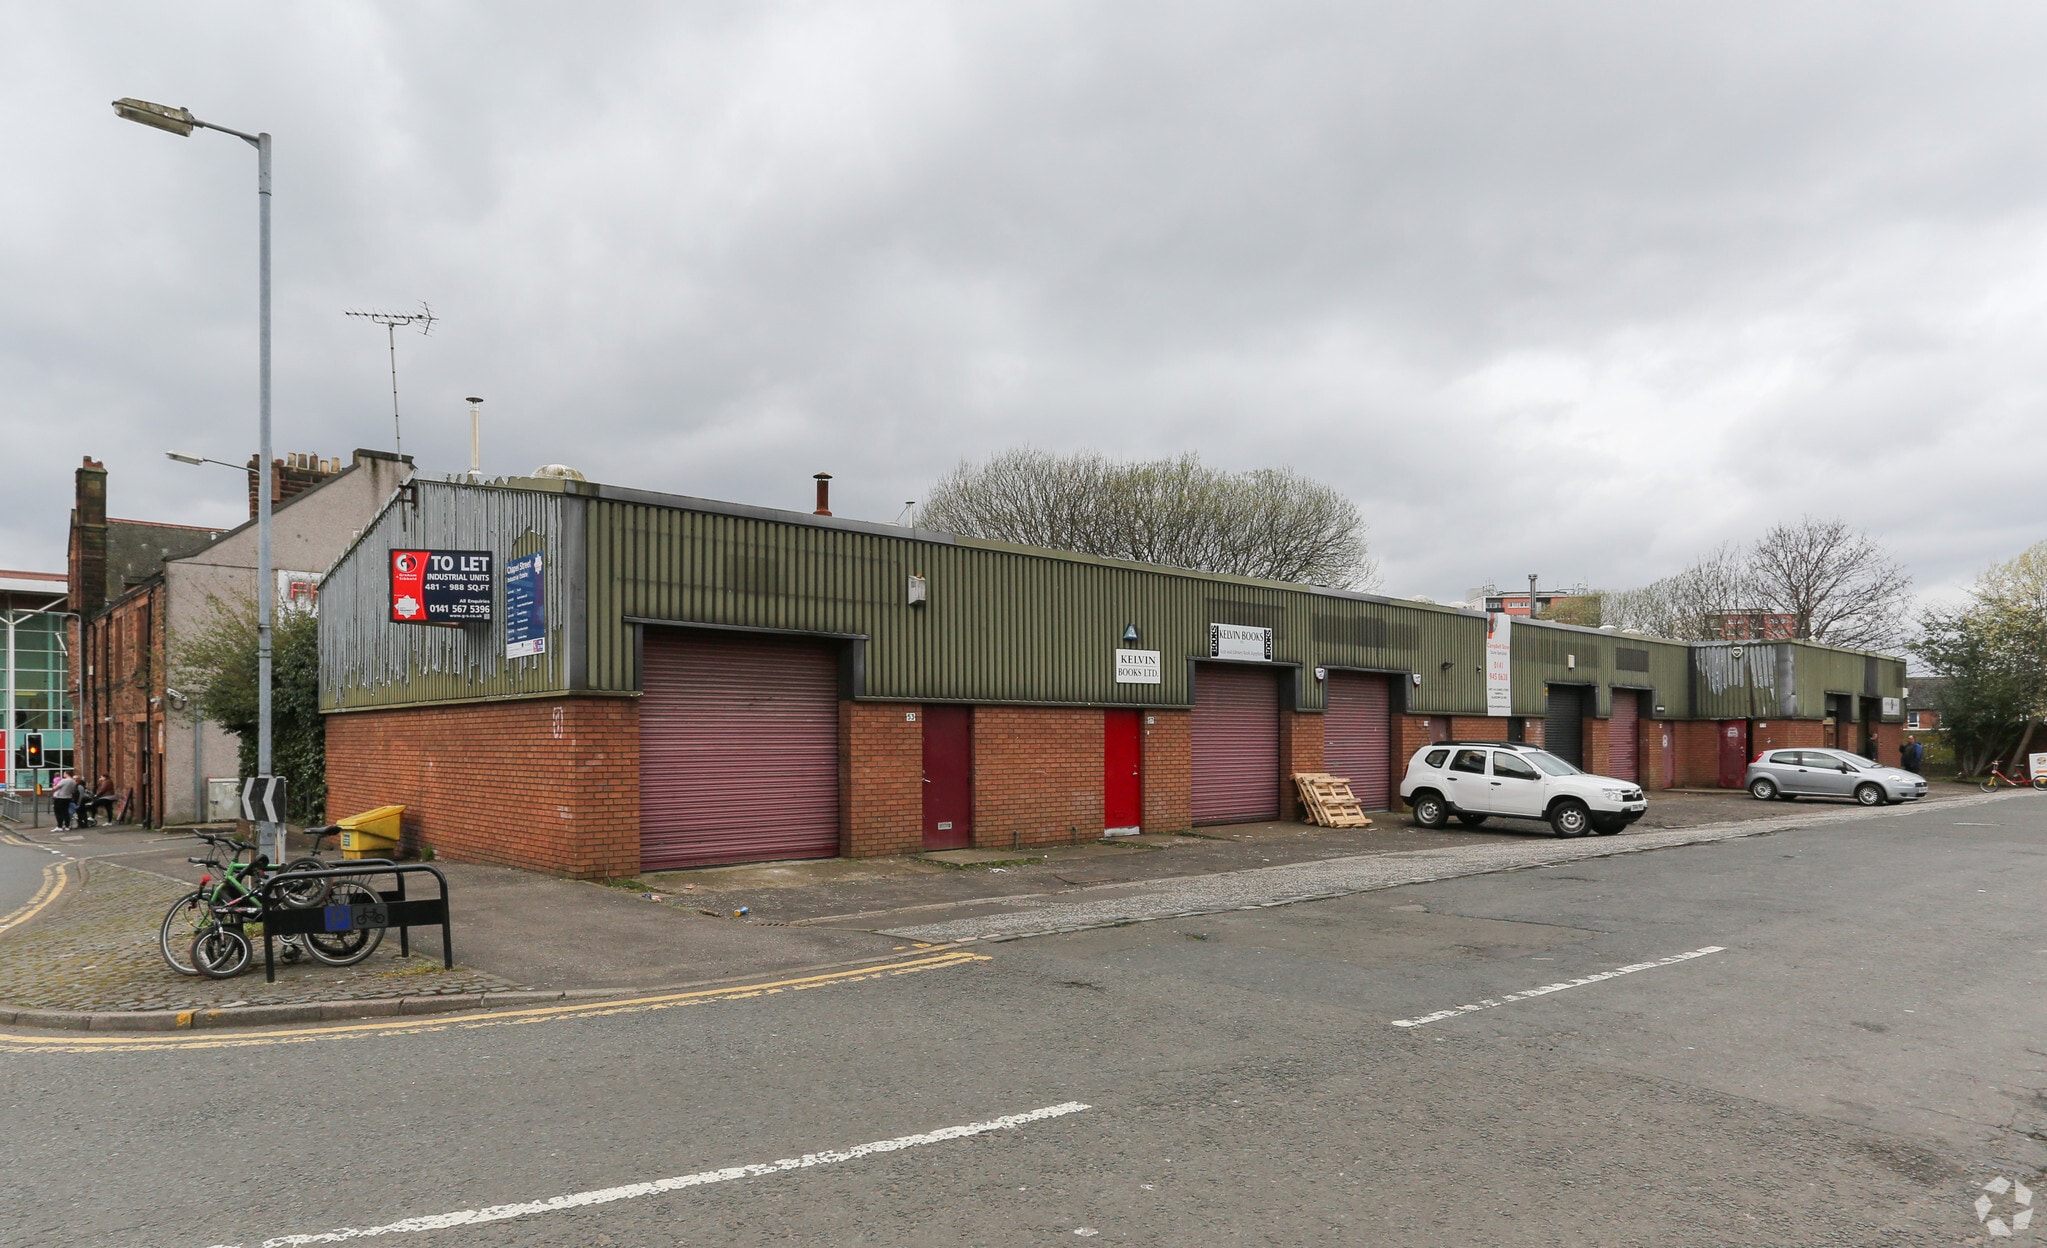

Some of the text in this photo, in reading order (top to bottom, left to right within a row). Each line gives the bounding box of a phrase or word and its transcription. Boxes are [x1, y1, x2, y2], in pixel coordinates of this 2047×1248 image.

[431, 555, 490, 572] TO LET
[520, 560, 532, 570] Street
[427, 573, 468, 581] INDUSTRIAL
[425, 583, 440, 591] 481
[467, 584, 490, 592] SQ.FT
[429, 604, 490, 614] 0141 567 5396
[1220, 629, 1264, 642] KELVIN BOOKS
[1121, 654, 1156, 665] KELVIN
[1118, 667, 1159, 678] BOOKS LTD.
[331, 909, 345, 928] P
